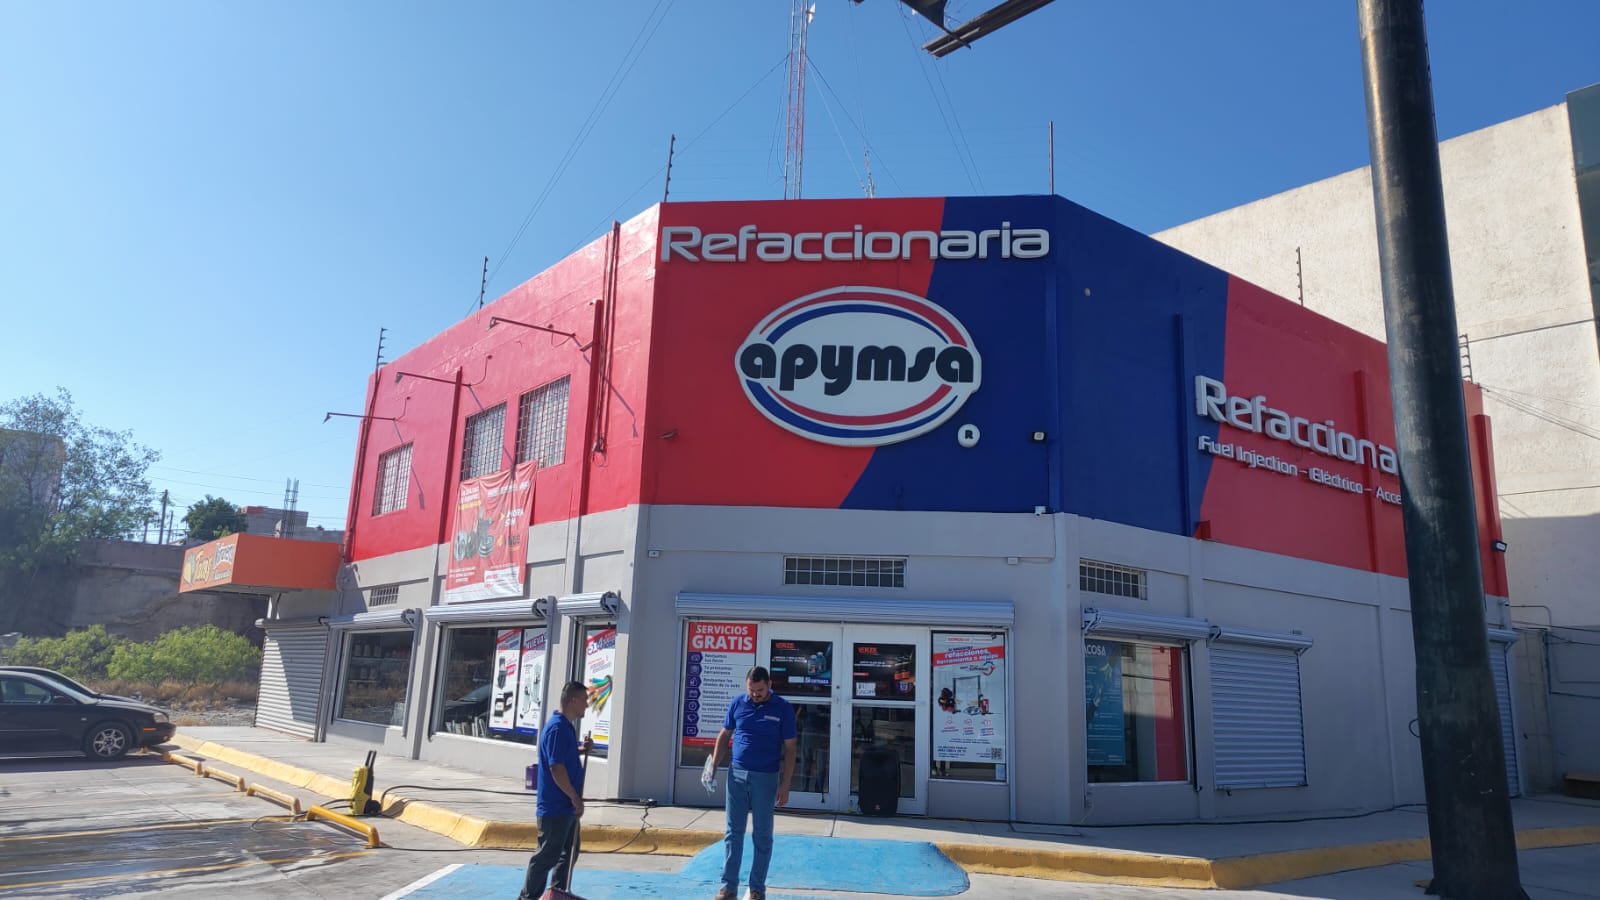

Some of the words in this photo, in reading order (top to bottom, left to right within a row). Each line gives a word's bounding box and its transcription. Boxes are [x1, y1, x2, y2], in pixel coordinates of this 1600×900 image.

[660, 221, 1050, 262] Refaccionaria
[739, 342, 974, 397] apymsa
[1198, 435, 1234, 459] Fuel
[1235, 446, 1298, 477] Injection
[1309, 466, 1364, 494] Eléctrico
[692, 635, 752, 650] GRATIS
[696, 625, 748, 635] SERVICIOS
